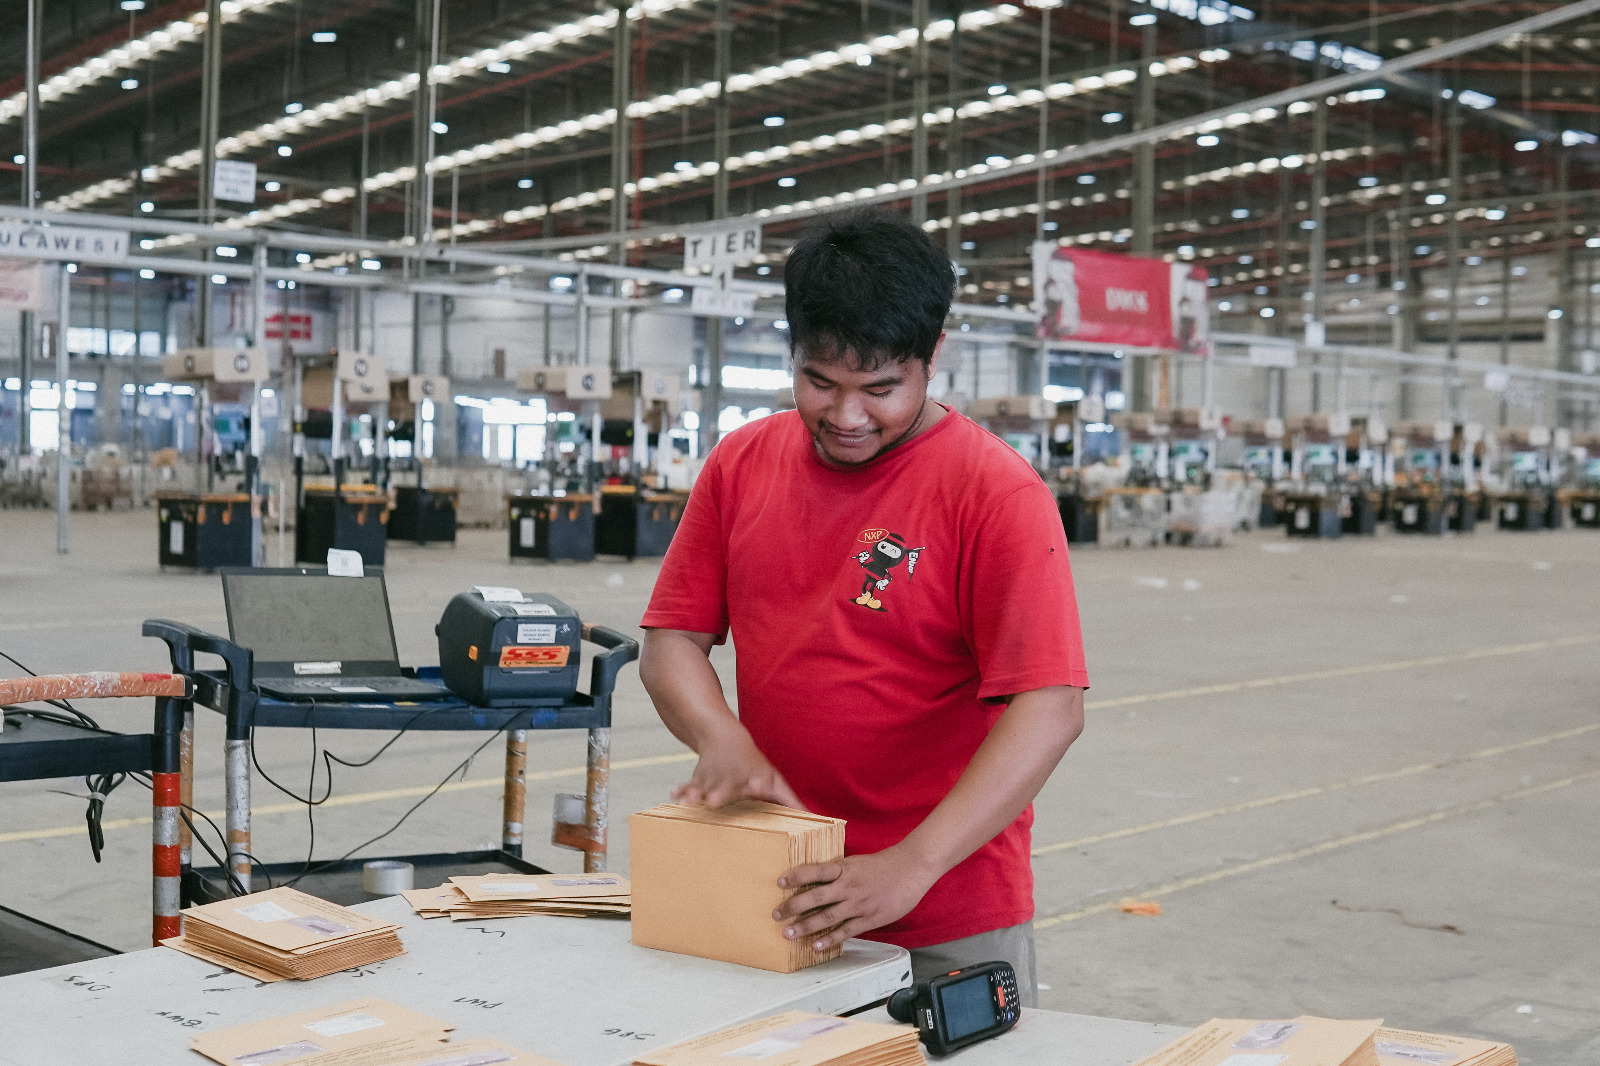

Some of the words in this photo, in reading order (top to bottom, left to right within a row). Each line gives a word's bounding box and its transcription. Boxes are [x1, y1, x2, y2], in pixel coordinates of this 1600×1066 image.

[690, 230, 756, 258] TIER
[719, 271, 726, 291] 1
[863, 530, 883, 541] NXP
